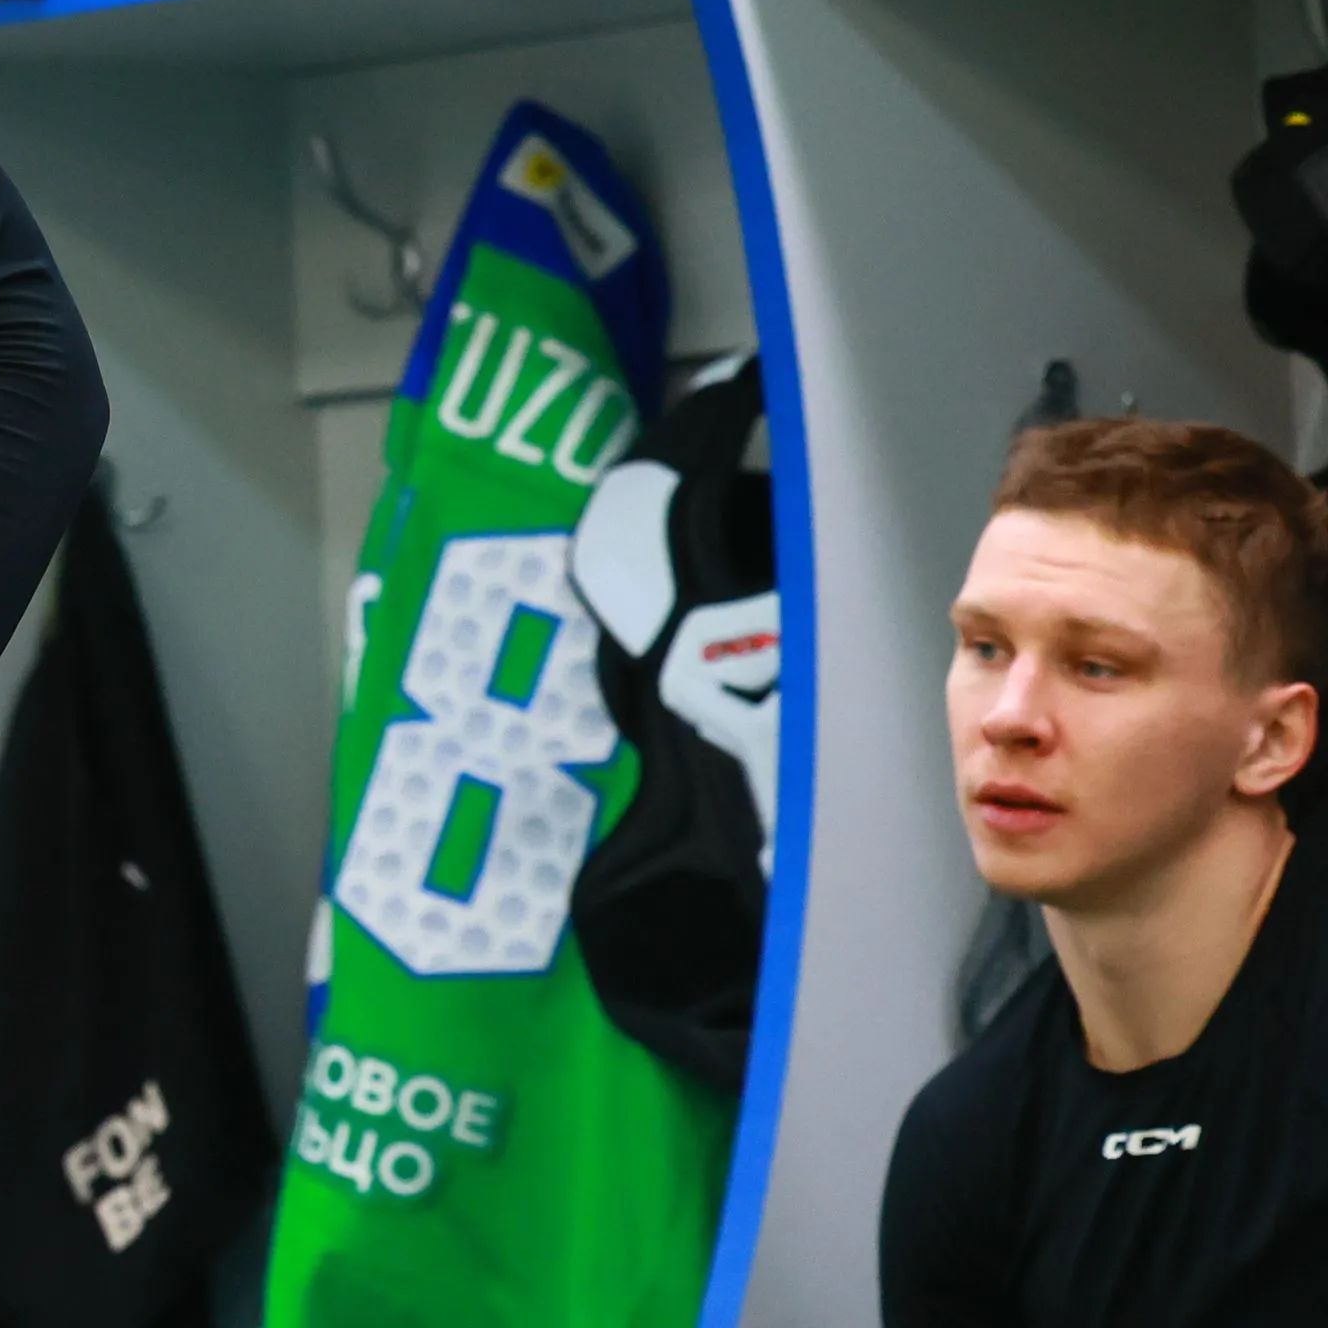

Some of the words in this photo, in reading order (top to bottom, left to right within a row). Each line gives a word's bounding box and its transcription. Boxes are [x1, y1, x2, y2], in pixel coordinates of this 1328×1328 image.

[438, 301, 639, 486] UZO
[62, 1078, 170, 1205] FON
[1102, 1124, 1202, 1159] CCM
